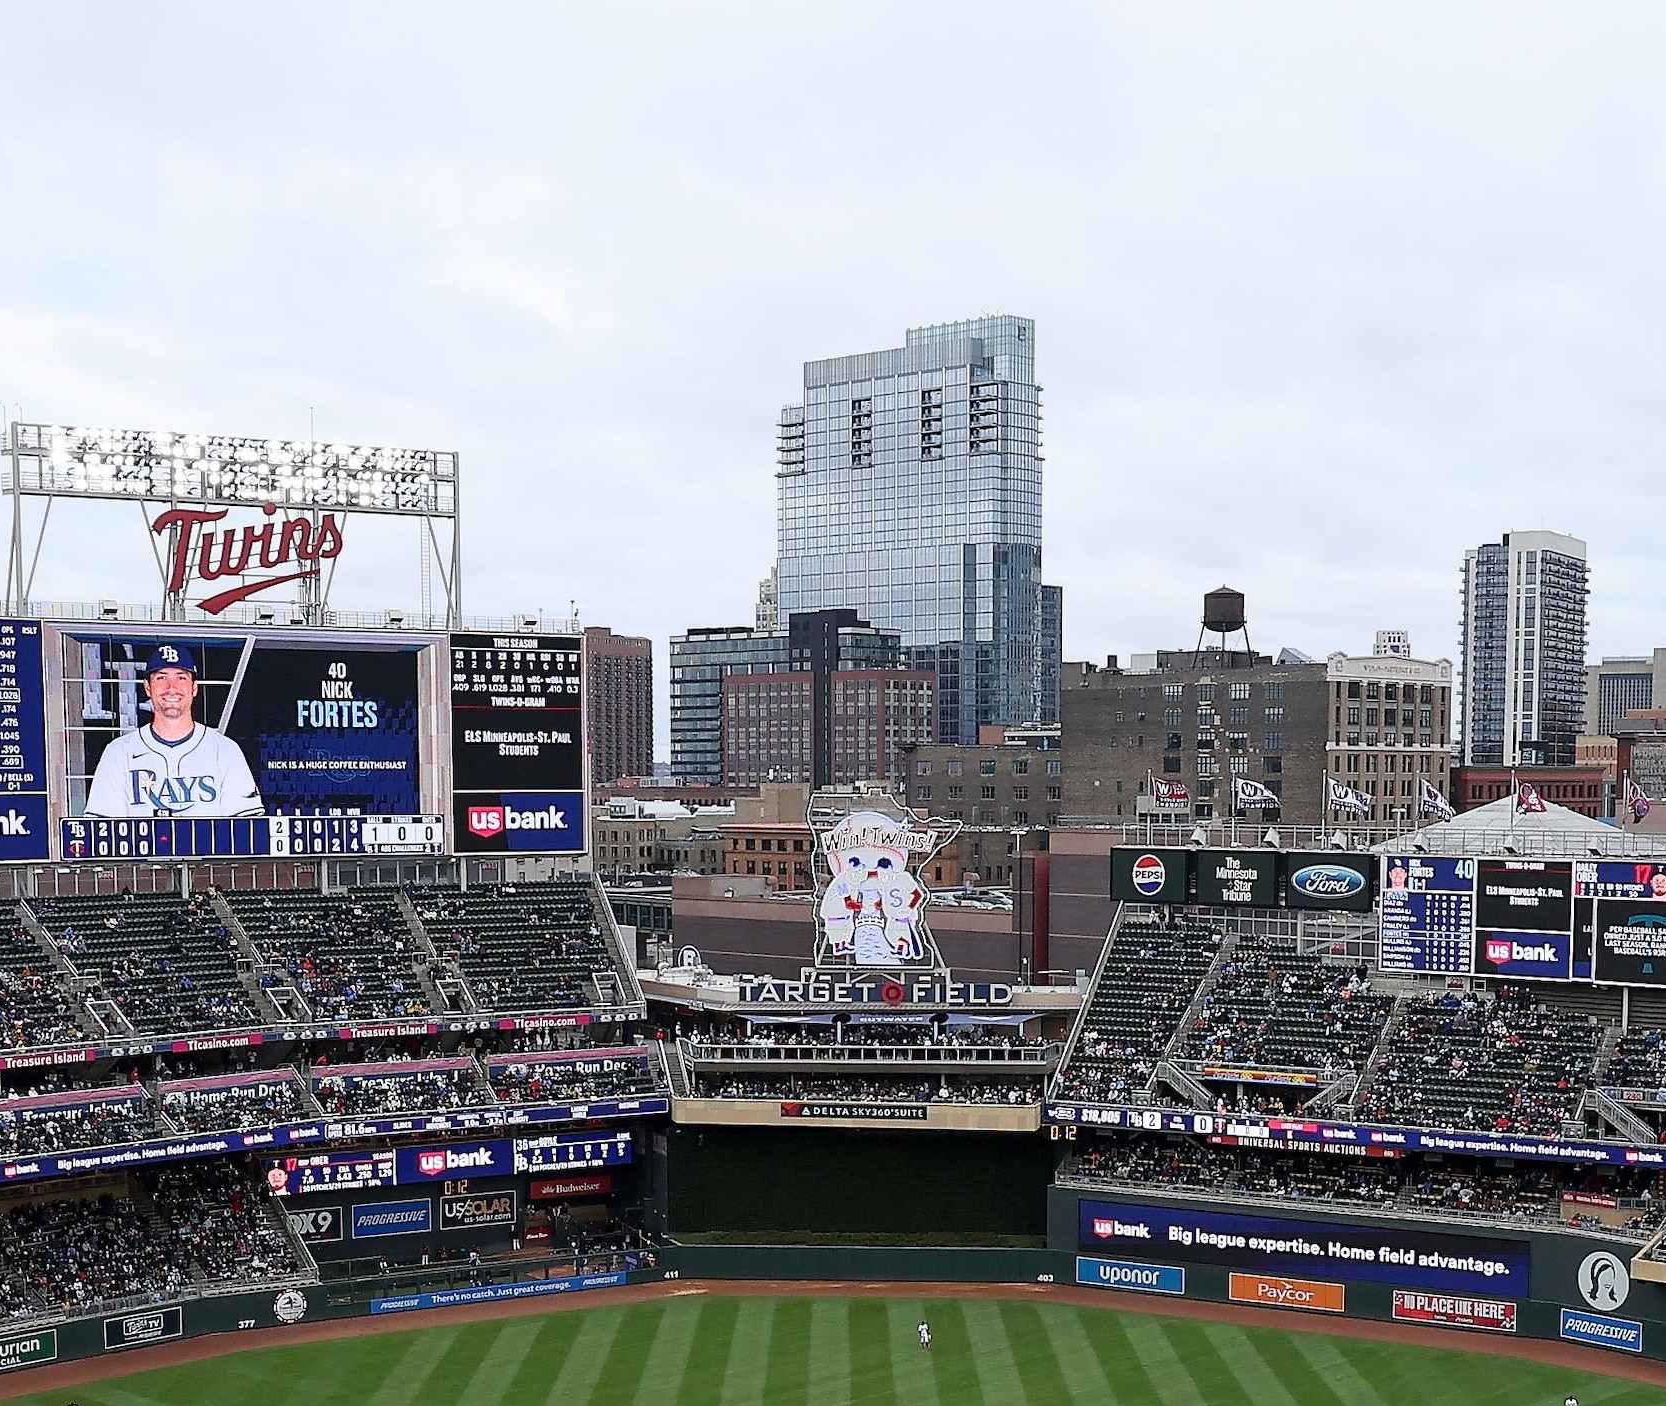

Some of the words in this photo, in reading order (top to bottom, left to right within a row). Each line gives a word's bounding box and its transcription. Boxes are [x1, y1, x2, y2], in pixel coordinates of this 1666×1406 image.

[151, 502, 343, 593] Twins
[493, 638, 510, 648] THIS
[511, 638, 538, 649] SEASON
[328, 663, 346, 679] 40
[322, 680, 353, 699] NICK
[297, 700, 378, 728] FORTES
[268, 761, 287, 769] NICK
[306, 761, 327, 769] HUGE
[329, 761, 358, 769] COFFEE
[359, 761, 406, 769] ENTHUSIAST
[822, 829, 867, 851] Win!
[870, 827, 936, 850] Twins!
[1224, 857, 1241, 869] The
[1455, 861, 1473, 879] 40
[1135, 871, 1163, 880] PEPSI
[1216, 868, 1257, 880] Minnesota
[1305, 871, 1350, 893] Ford
[1222, 889, 1252, 901] Tribune
[1233, 881, 1252, 891] Star
[740, 983, 876, 1003] TARGET
[913, 983, 1013, 1004] FIELD
[350, 1027, 394, 1038] Treasure
[396, 1024, 428, 1036] Island
[4, 1053, 52, 1068] Treasure
[53, 1051, 85, 1064] Island
[813, 1106, 849, 1116] DELTA
[1238, 1136, 1285, 1149] UNIVERSAL
[1287, 1140, 1321, 1152] SPORTS
[1324, 1142, 1367, 1156] AUCTIONS
[556, 1181, 600, 1193] Budweiser
[357, 1210, 426, 1227] PROGRESSIVE
[1168, 1225, 1193, 1245] Big
[1195, 1230, 1246, 1249] league
[1248, 1236, 1324, 1258] expertise.
[1328, 1241, 1375, 1261] Home
[1378, 1245, 1415, 1265] field
[1418, 1251, 1510, 1276] advantage.
[1098, 1263, 1160, 1287] uponor
[431, 1293, 461, 1304] There's
[461, 1292, 471, 1300] no
[472, 1289, 496, 1300] catch.
[496, 1287, 512, 1297] Just
[514, 1285, 534, 1297] great
[535, 1281, 571, 1294] coverage.
[1258, 1281, 1314, 1302] Paycor
[1416, 1296, 1453, 1315] PLACE
[1454, 1300, 1473, 1316] LIKE
[1473, 1302, 1505, 1319] HERE
[1565, 1317, 1638, 1343] PROGRESSIVE
